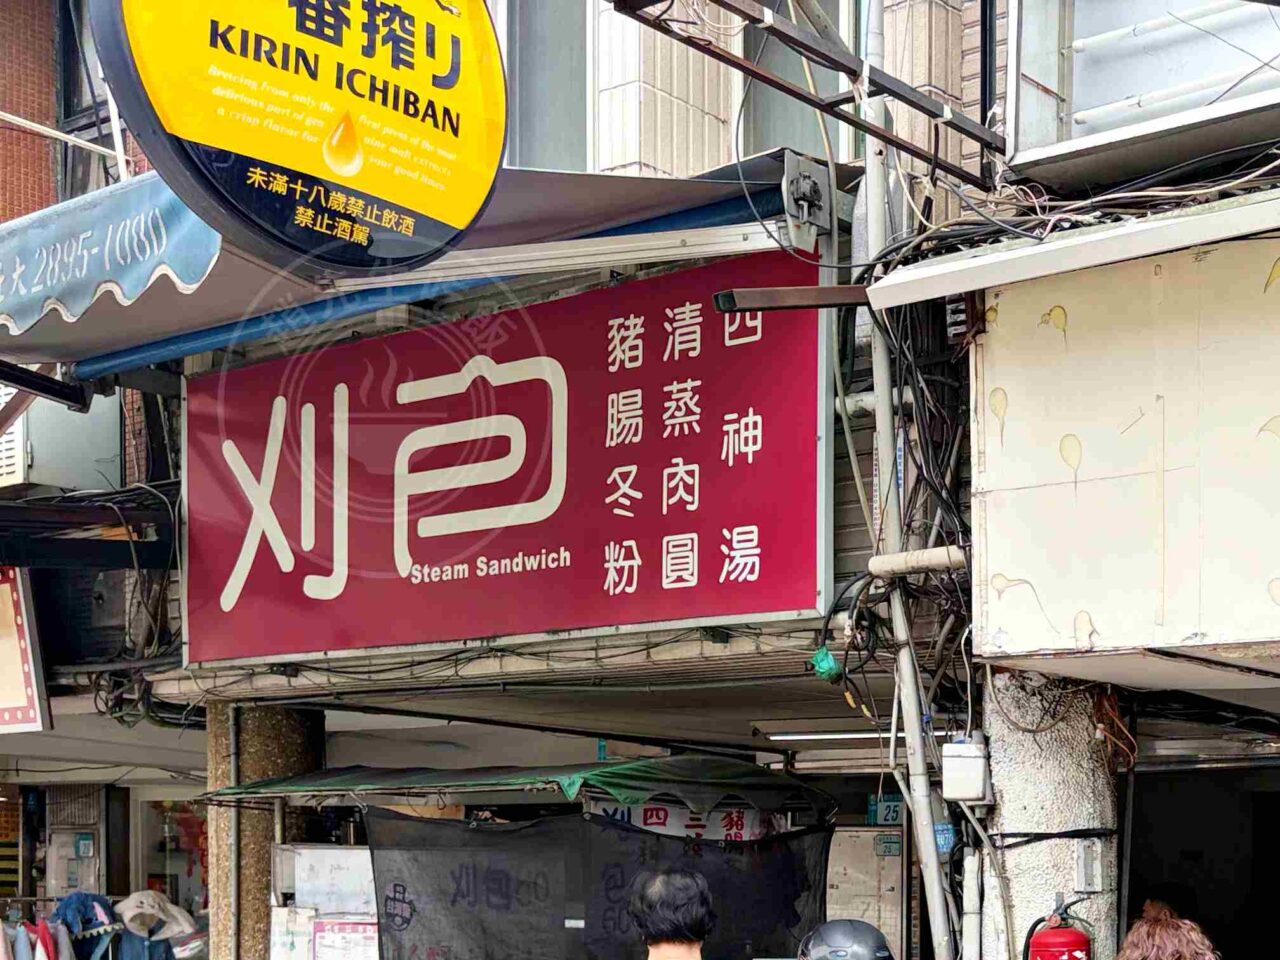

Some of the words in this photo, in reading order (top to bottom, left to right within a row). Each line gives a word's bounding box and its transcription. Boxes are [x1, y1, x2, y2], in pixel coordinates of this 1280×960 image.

[209, 19, 320, 82] KIRIN
[335, 61, 461, 138] ICHIBAN
[246, 167, 416, 238] 未滿十八歲禁止飲酒
[294, 206, 371, 246] 禁止酒駕
[219, 355, 569, 612] 刈包
[603, 313, 645, 596] 豬腸冬粉
[662, 302, 704, 590] 清蒸肉圓
[719, 311, 763, 584] 四神湯
[410, 560, 469, 585] Steam
[475, 547, 571, 579] Sandwich
[883, 804, 899, 822] 25
